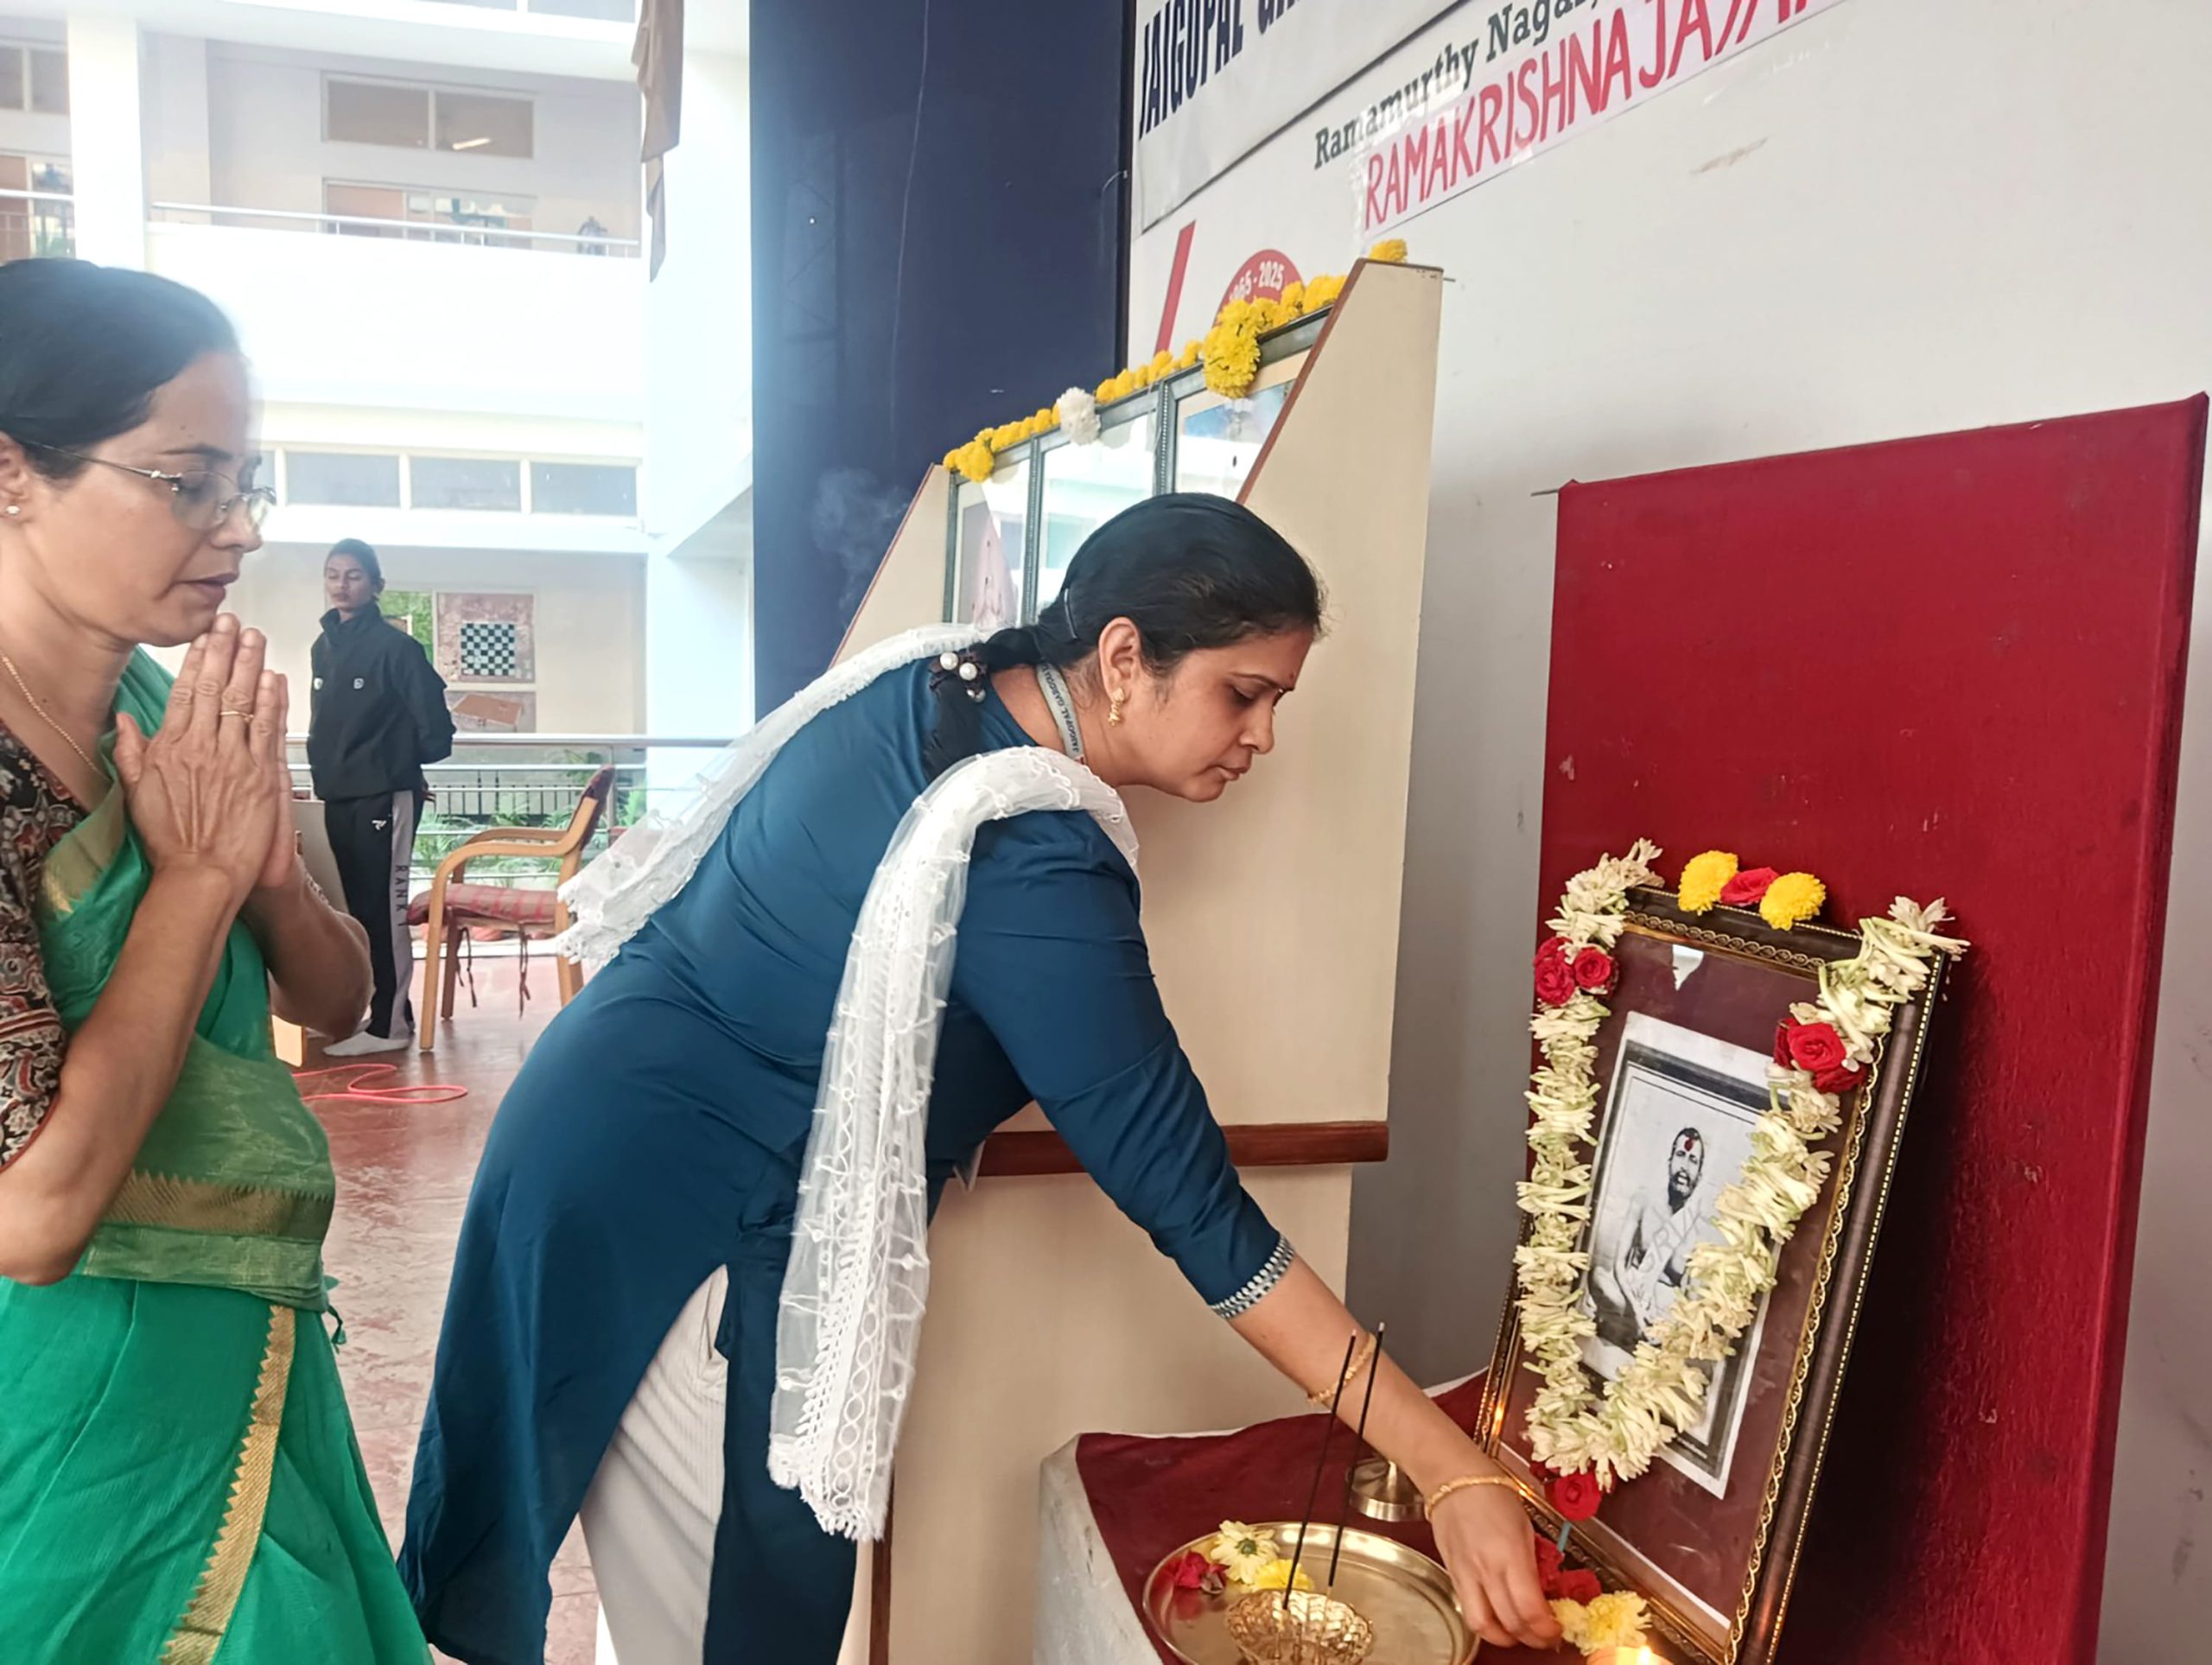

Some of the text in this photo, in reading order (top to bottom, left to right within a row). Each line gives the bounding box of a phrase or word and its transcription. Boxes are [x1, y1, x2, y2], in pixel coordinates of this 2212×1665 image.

[1139, 0, 1243, 142] JAIGOPAL
[1314, 0, 1598, 170] Ramamurthy Naga,
[1365, 8, 1632, 231] RAMAKRISHNA
[1258, 260, 1285, 291] 2025
[395, 865, 409, 912] RANK
